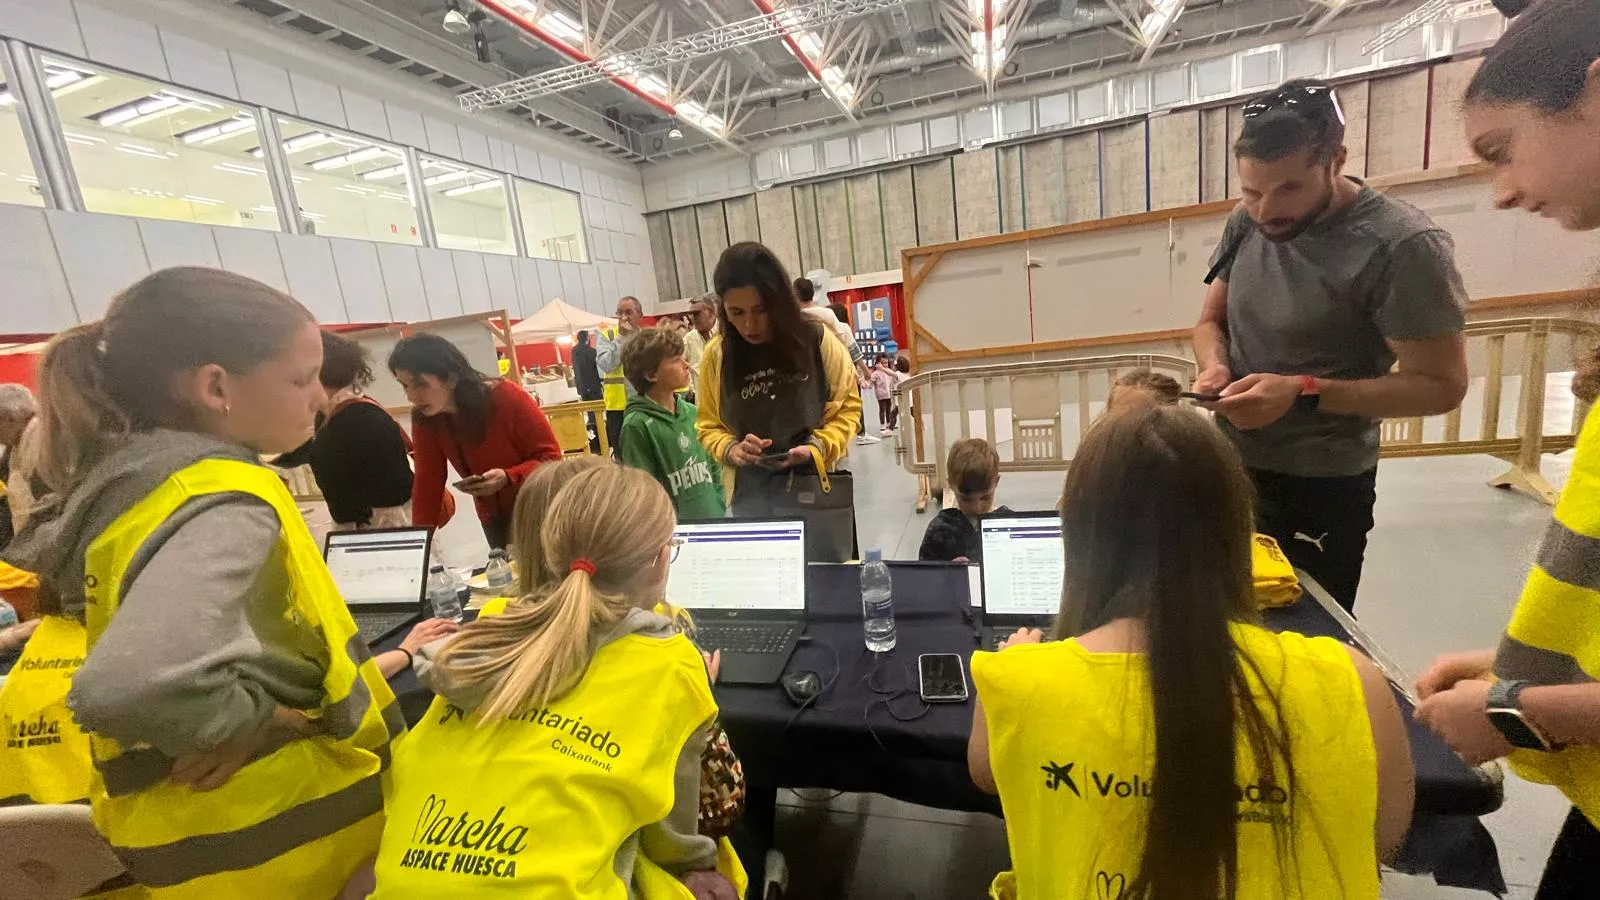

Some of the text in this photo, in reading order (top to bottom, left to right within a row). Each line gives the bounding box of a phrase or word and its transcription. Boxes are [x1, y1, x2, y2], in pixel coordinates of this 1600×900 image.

[507, 706, 621, 758] untariado
[551, 738, 613, 773] CaixaBank
[411, 793, 529, 855] Marcha
[400, 848, 517, 878] ASPACE HUESCA
